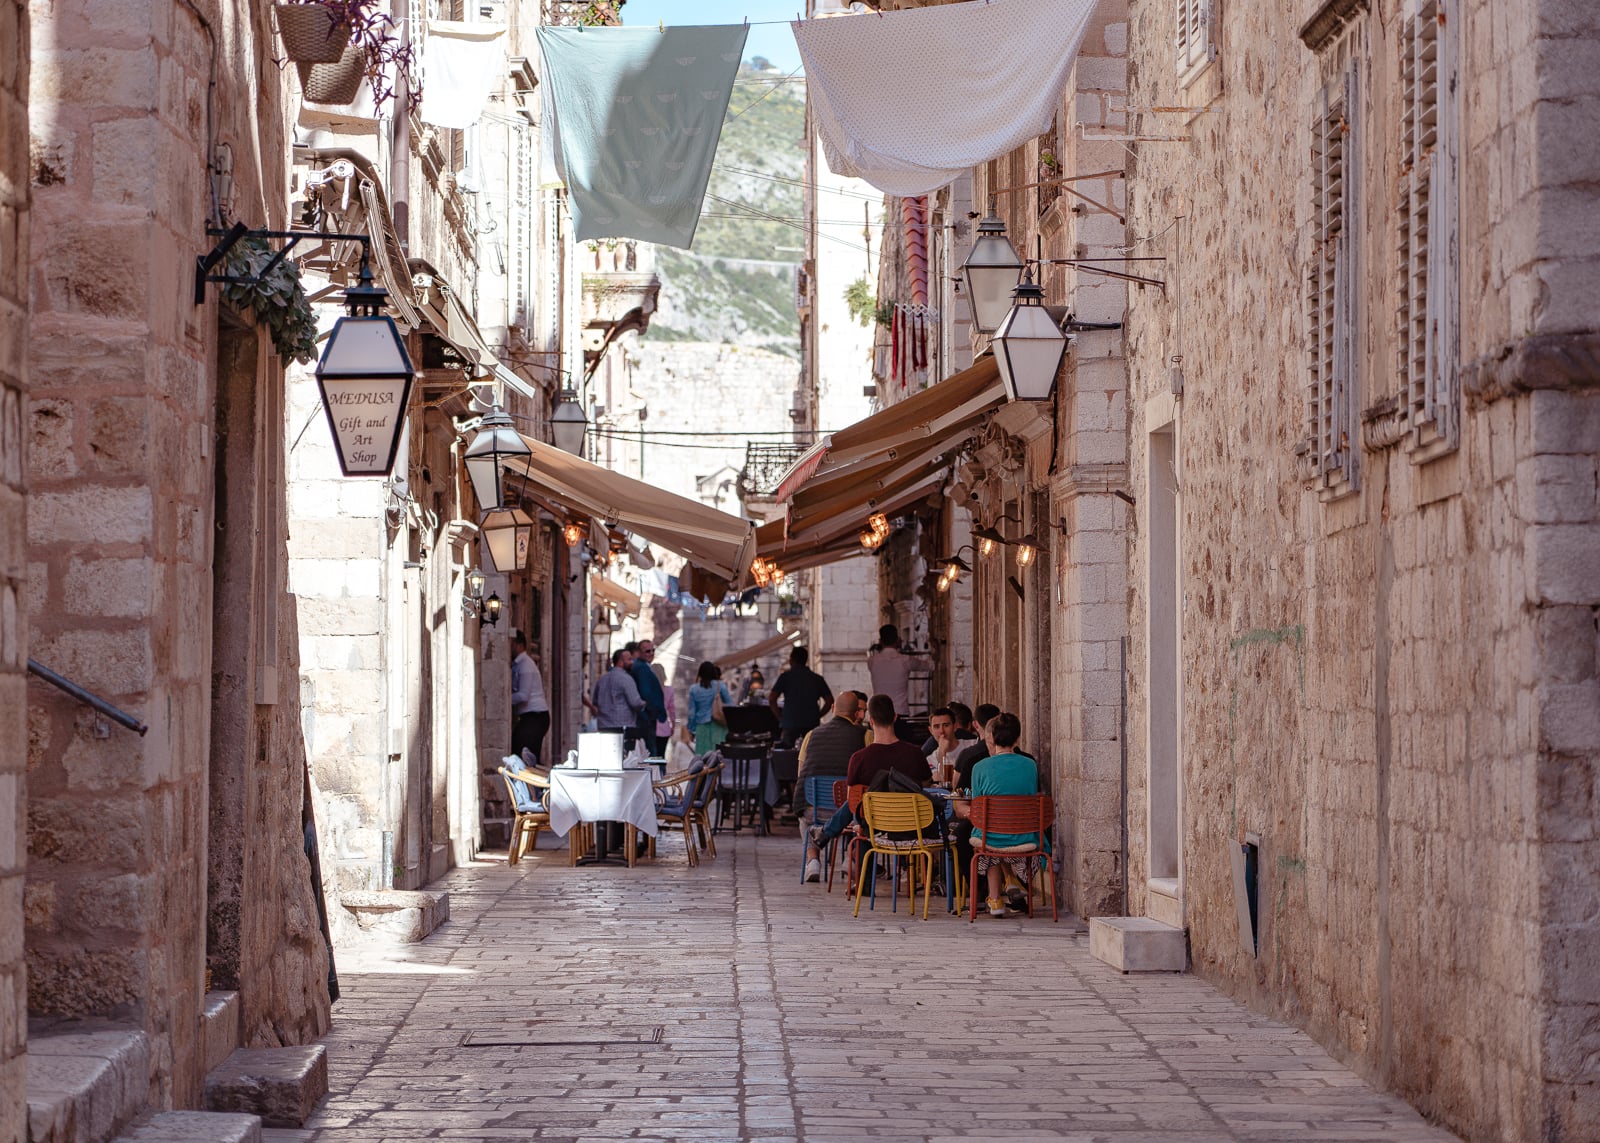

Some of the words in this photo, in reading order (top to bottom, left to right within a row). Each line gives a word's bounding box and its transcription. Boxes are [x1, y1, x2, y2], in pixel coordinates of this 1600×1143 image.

[330, 391, 394, 405] MEDUSA
[339, 415, 362, 432] Gift
[366, 415, 388, 428] and
[352, 434, 373, 446] Art
[349, 449, 377, 467] Shop
